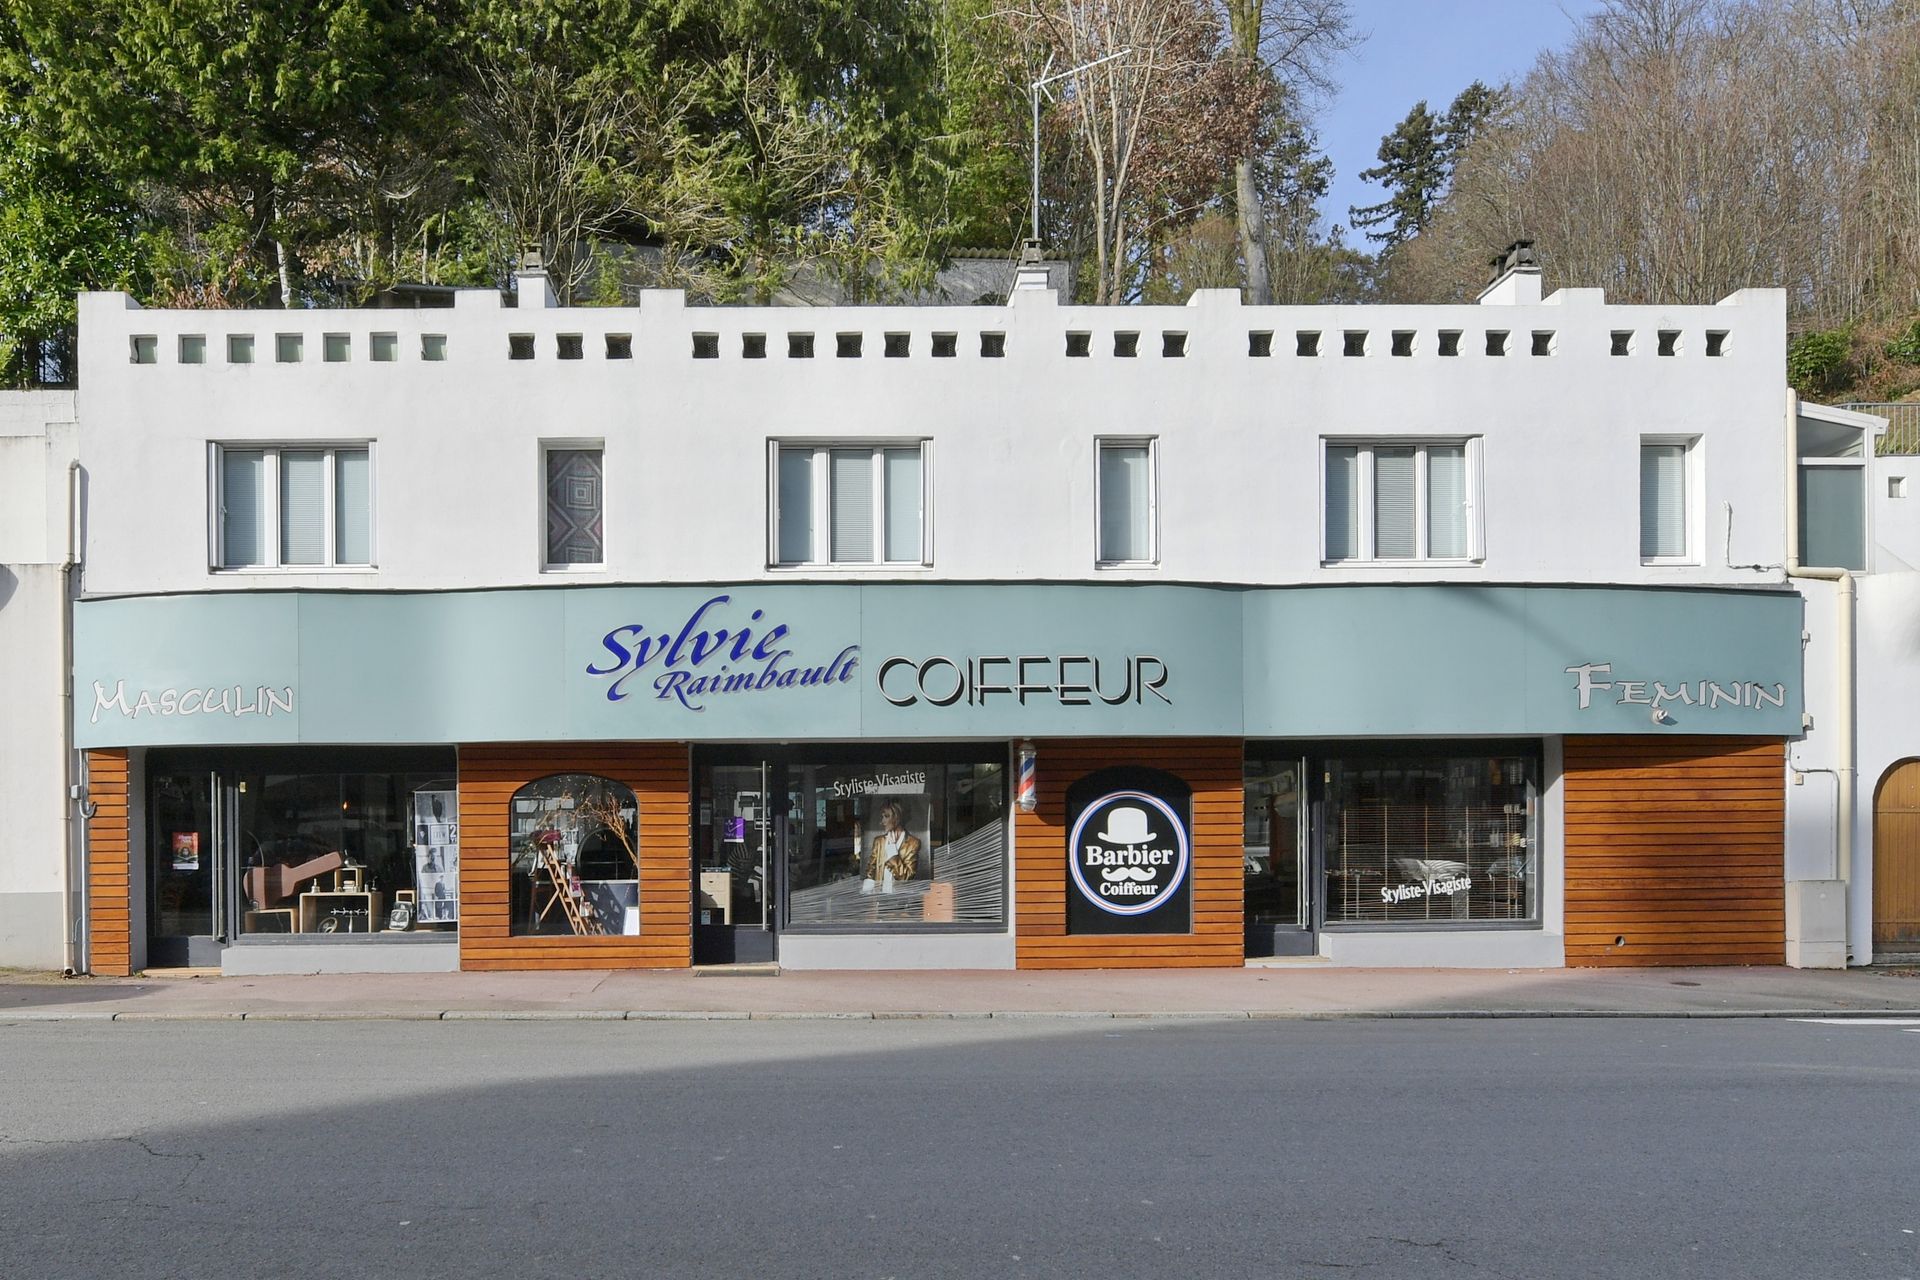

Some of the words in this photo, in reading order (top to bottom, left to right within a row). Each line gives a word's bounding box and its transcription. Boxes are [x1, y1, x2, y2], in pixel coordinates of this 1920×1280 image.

[586, 595, 789, 701] Sylvie
[653, 645, 860, 711] Raimbault
[877, 656, 1172, 706] COIFFEUR
[1565, 663, 1786, 710] FEMININ
[90, 679, 294, 724] MASCULIN
[833, 770, 926, 798] Styliste-Visagiste
[1085, 844, 1174, 866] Barbier
[1099, 882, 1159, 896] Coiffeur
[1381, 876, 1472, 904] Styliste-Visagiste
